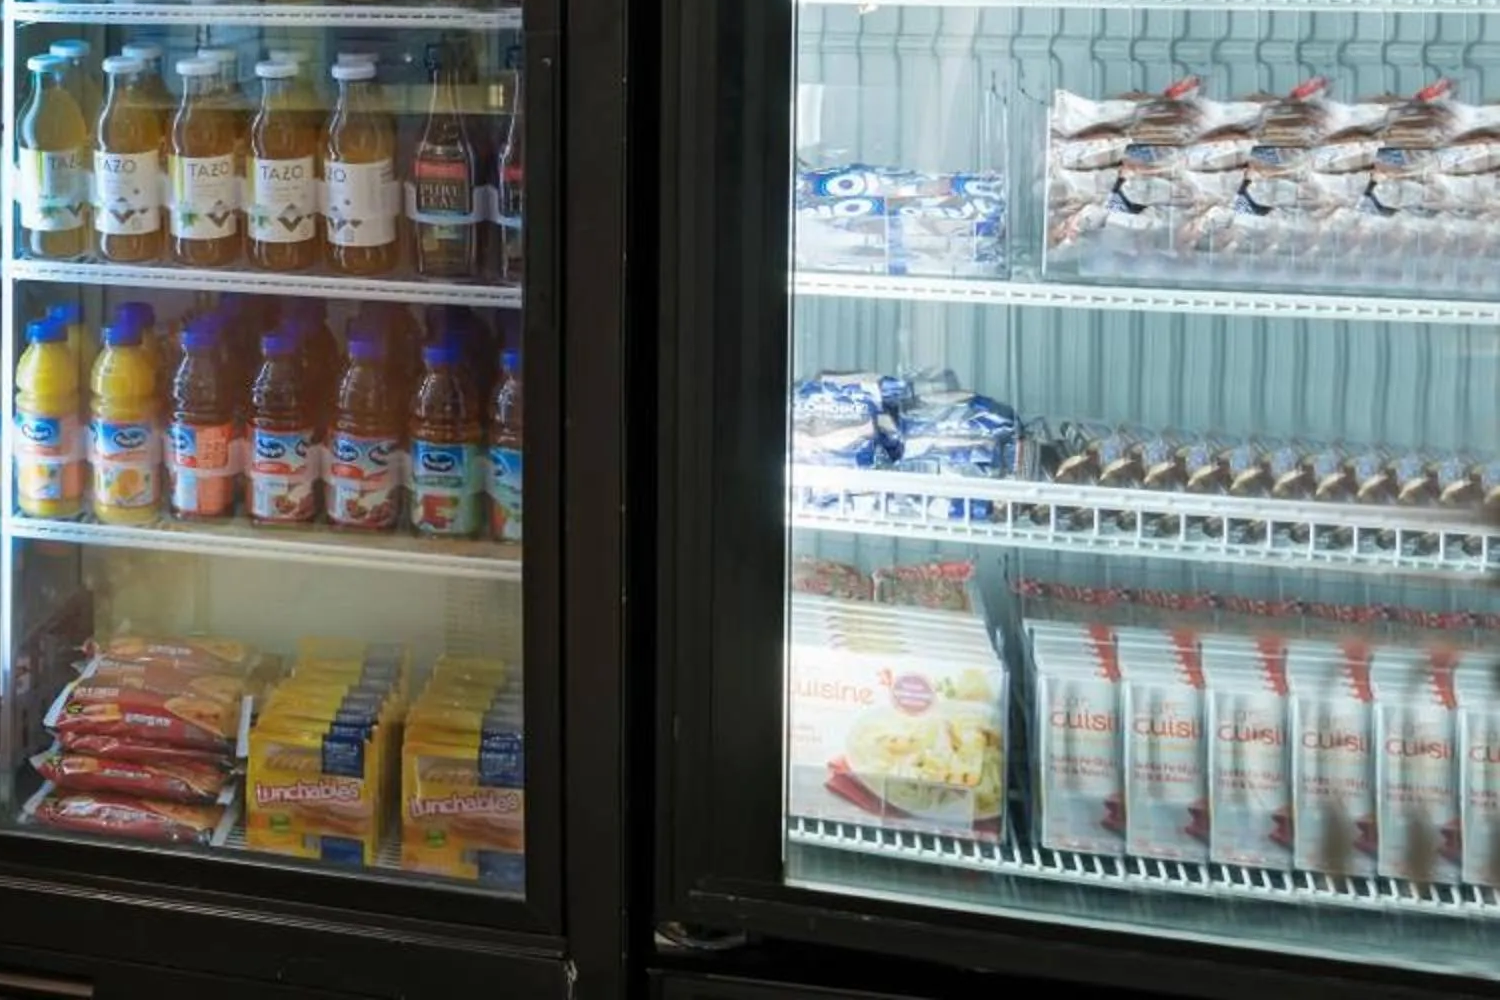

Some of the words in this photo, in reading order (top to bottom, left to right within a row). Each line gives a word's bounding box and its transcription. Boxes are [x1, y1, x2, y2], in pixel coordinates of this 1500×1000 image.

[188, 161, 230, 178] TAZO
[260, 164, 305, 182] TAZO
[1050, 709, 1115, 732] cuisi
[1132, 717, 1201, 741] cuisi
[1216, 722, 1284, 746] cuisi
[1301, 730, 1368, 753] cuisi
[1385, 737, 1451, 761] cuisi
[256, 780, 360, 804] Lunchables
